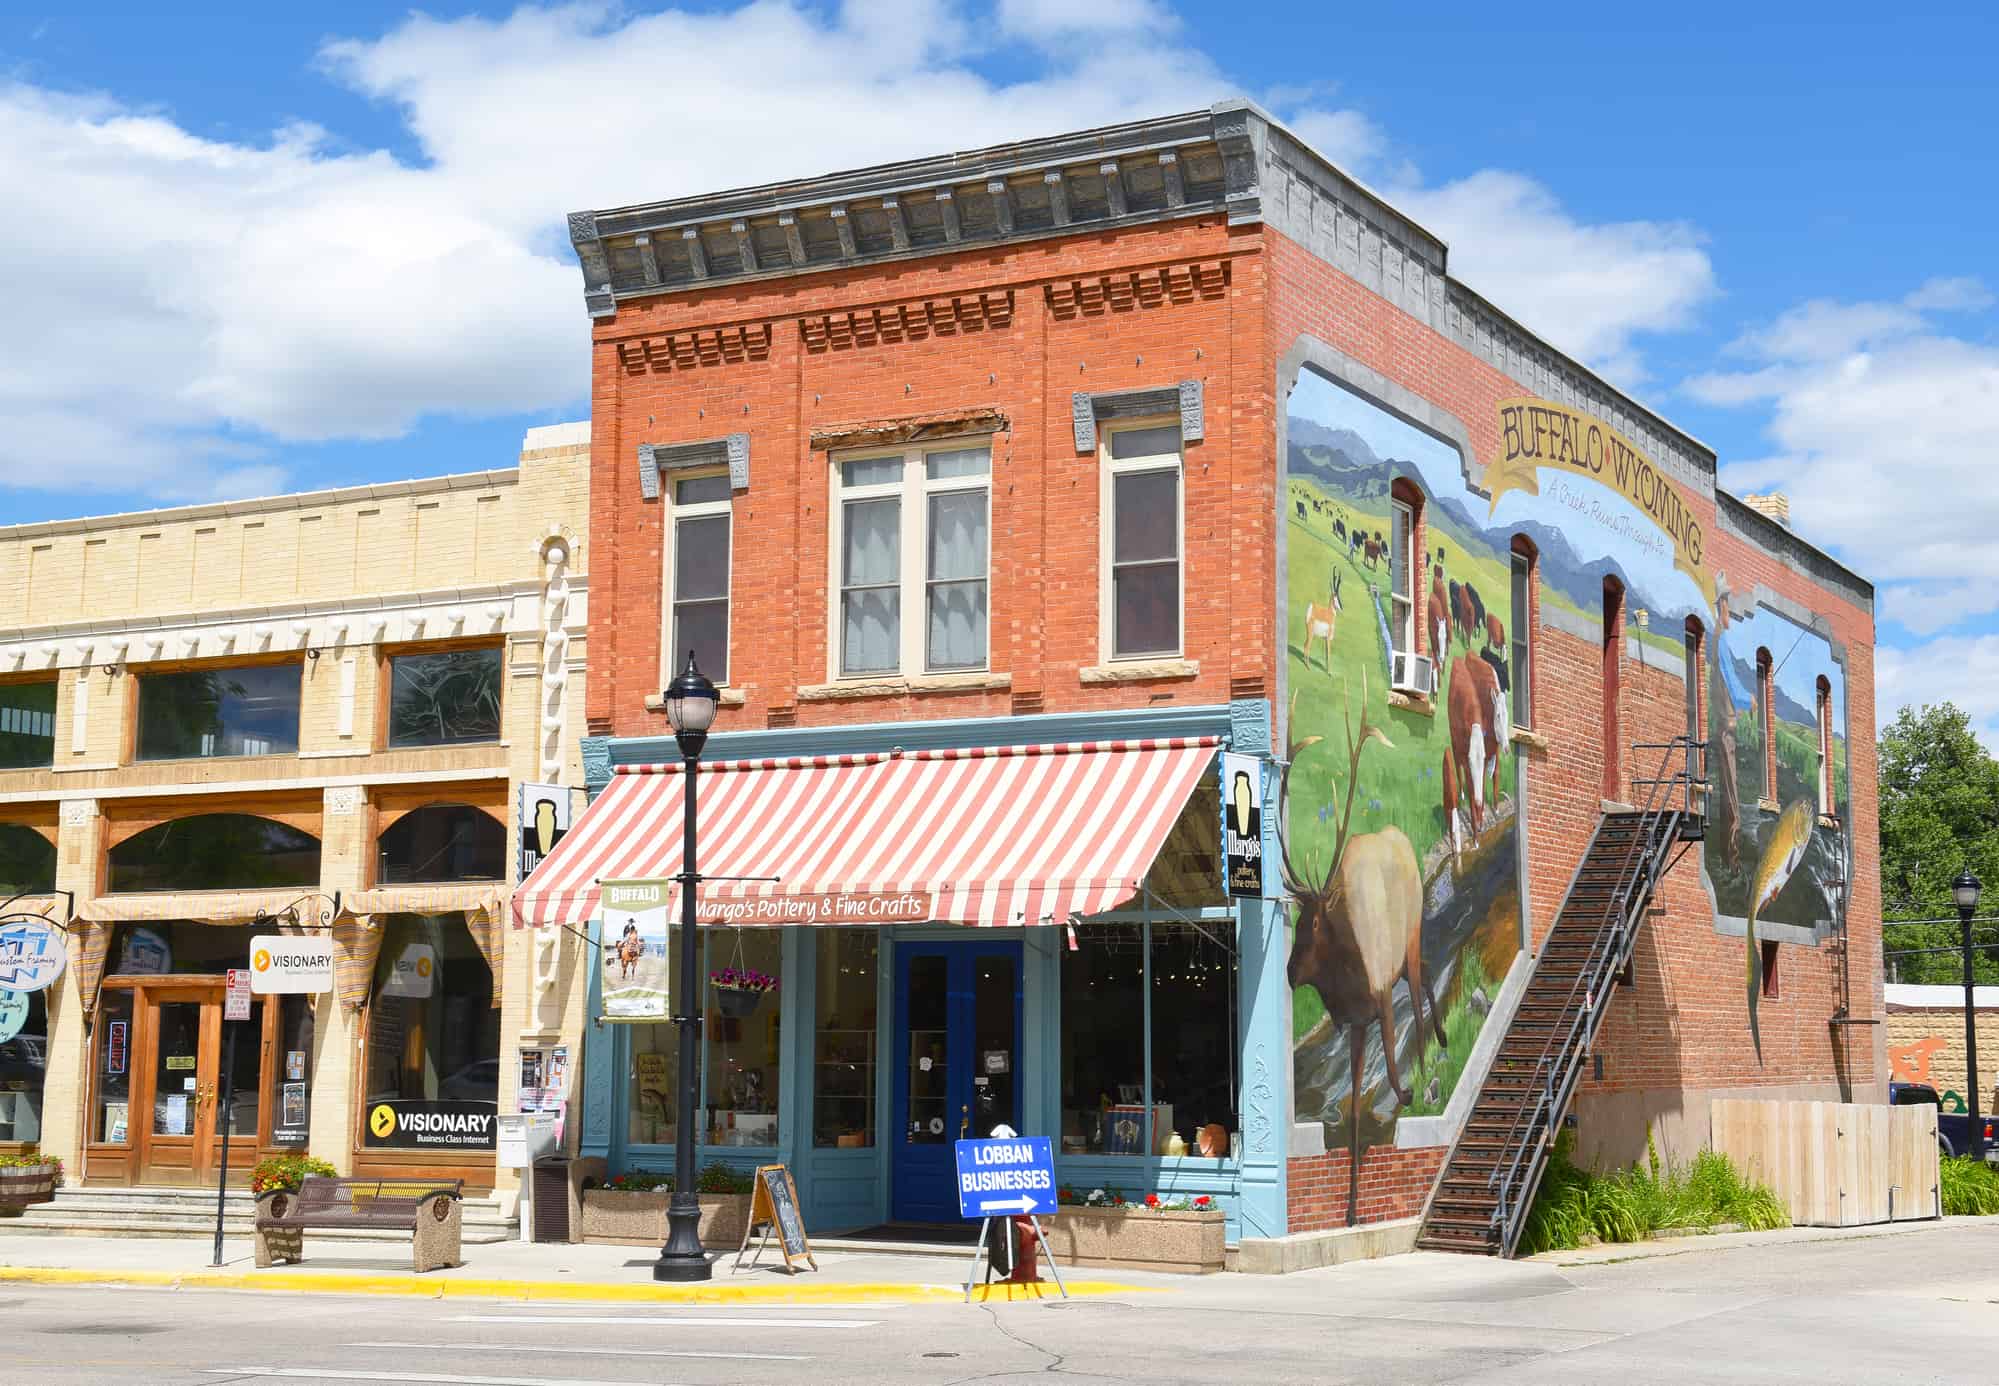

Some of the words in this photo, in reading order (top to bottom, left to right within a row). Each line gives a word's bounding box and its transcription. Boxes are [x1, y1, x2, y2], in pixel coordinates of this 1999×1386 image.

[1502, 406, 1604, 473] BUFFALO
[1610, 435, 1702, 565] WYOMING
[1227, 829, 1261, 862] Margo's
[611, 887, 660, 903] BUFFALO
[695, 899, 755, 923] Margo's
[757, 898, 817, 923] Pottery
[820, 898, 832, 915] &
[835, 896, 866, 916] Fine
[870, 894, 922, 916] Crafts
[272, 955, 331, 968] VISIONARY
[228, 971, 236, 987] 2
[398, 1113, 491, 1133] VISIONARY
[416, 1134, 445, 1143] Business
[445, 1134, 462, 1144] Class
[462, 1135, 490, 1144] Internet
[974, 1144, 1034, 1165] LOBBAN
[962, 1169, 1051, 1193] BUSINESSES
